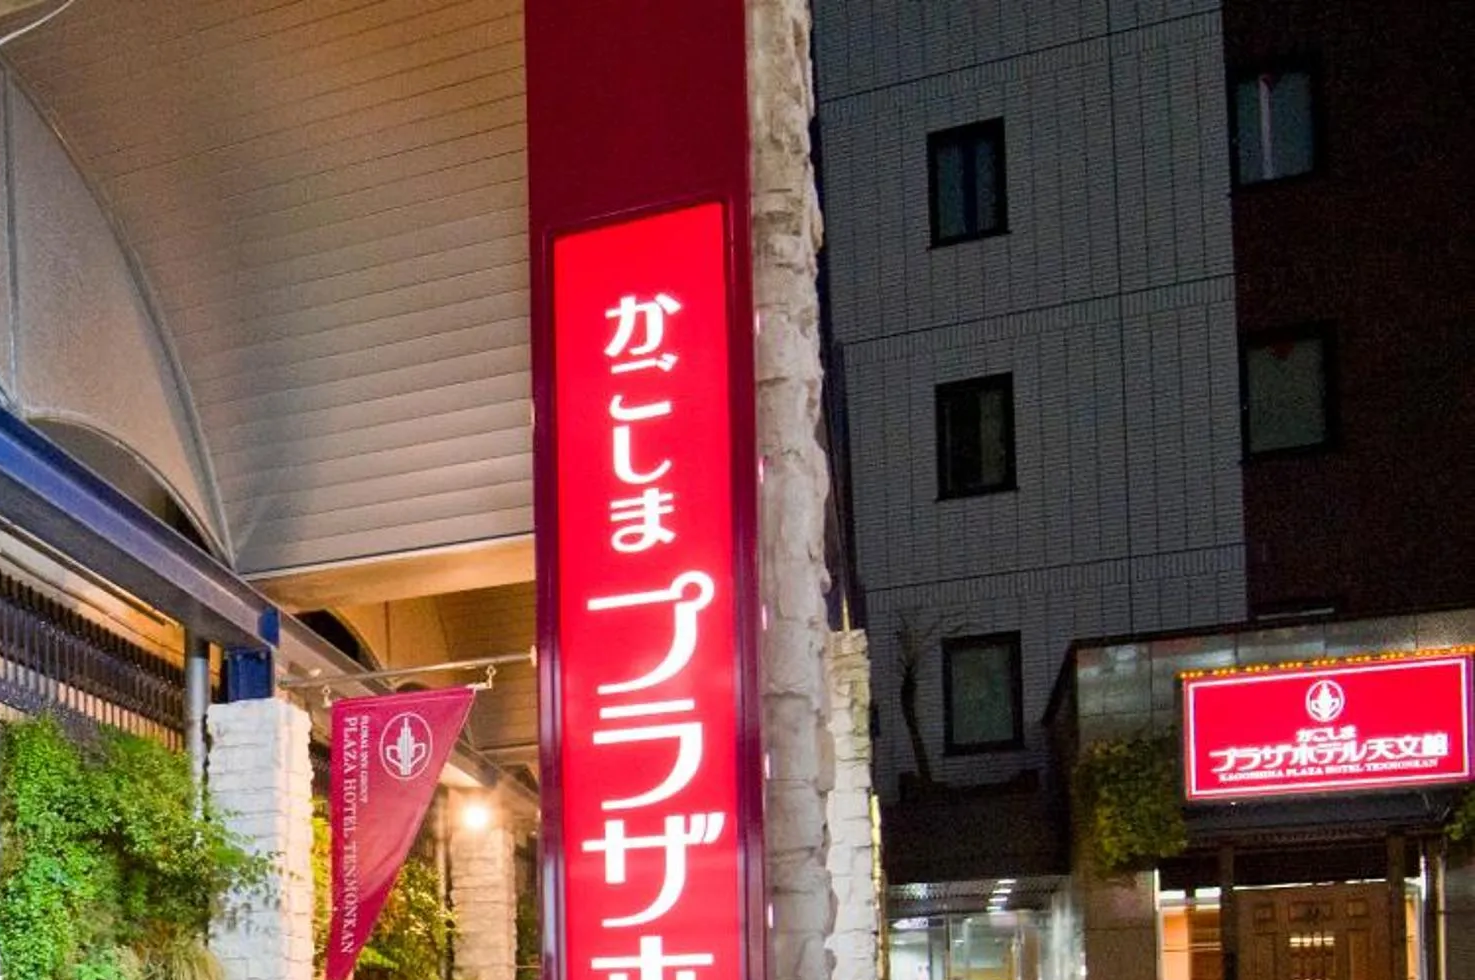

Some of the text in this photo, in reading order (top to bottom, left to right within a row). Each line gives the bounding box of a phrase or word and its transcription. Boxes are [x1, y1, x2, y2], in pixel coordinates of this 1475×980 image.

[341, 717, 358, 953] PLAZA HOTEL TENMONKAN
